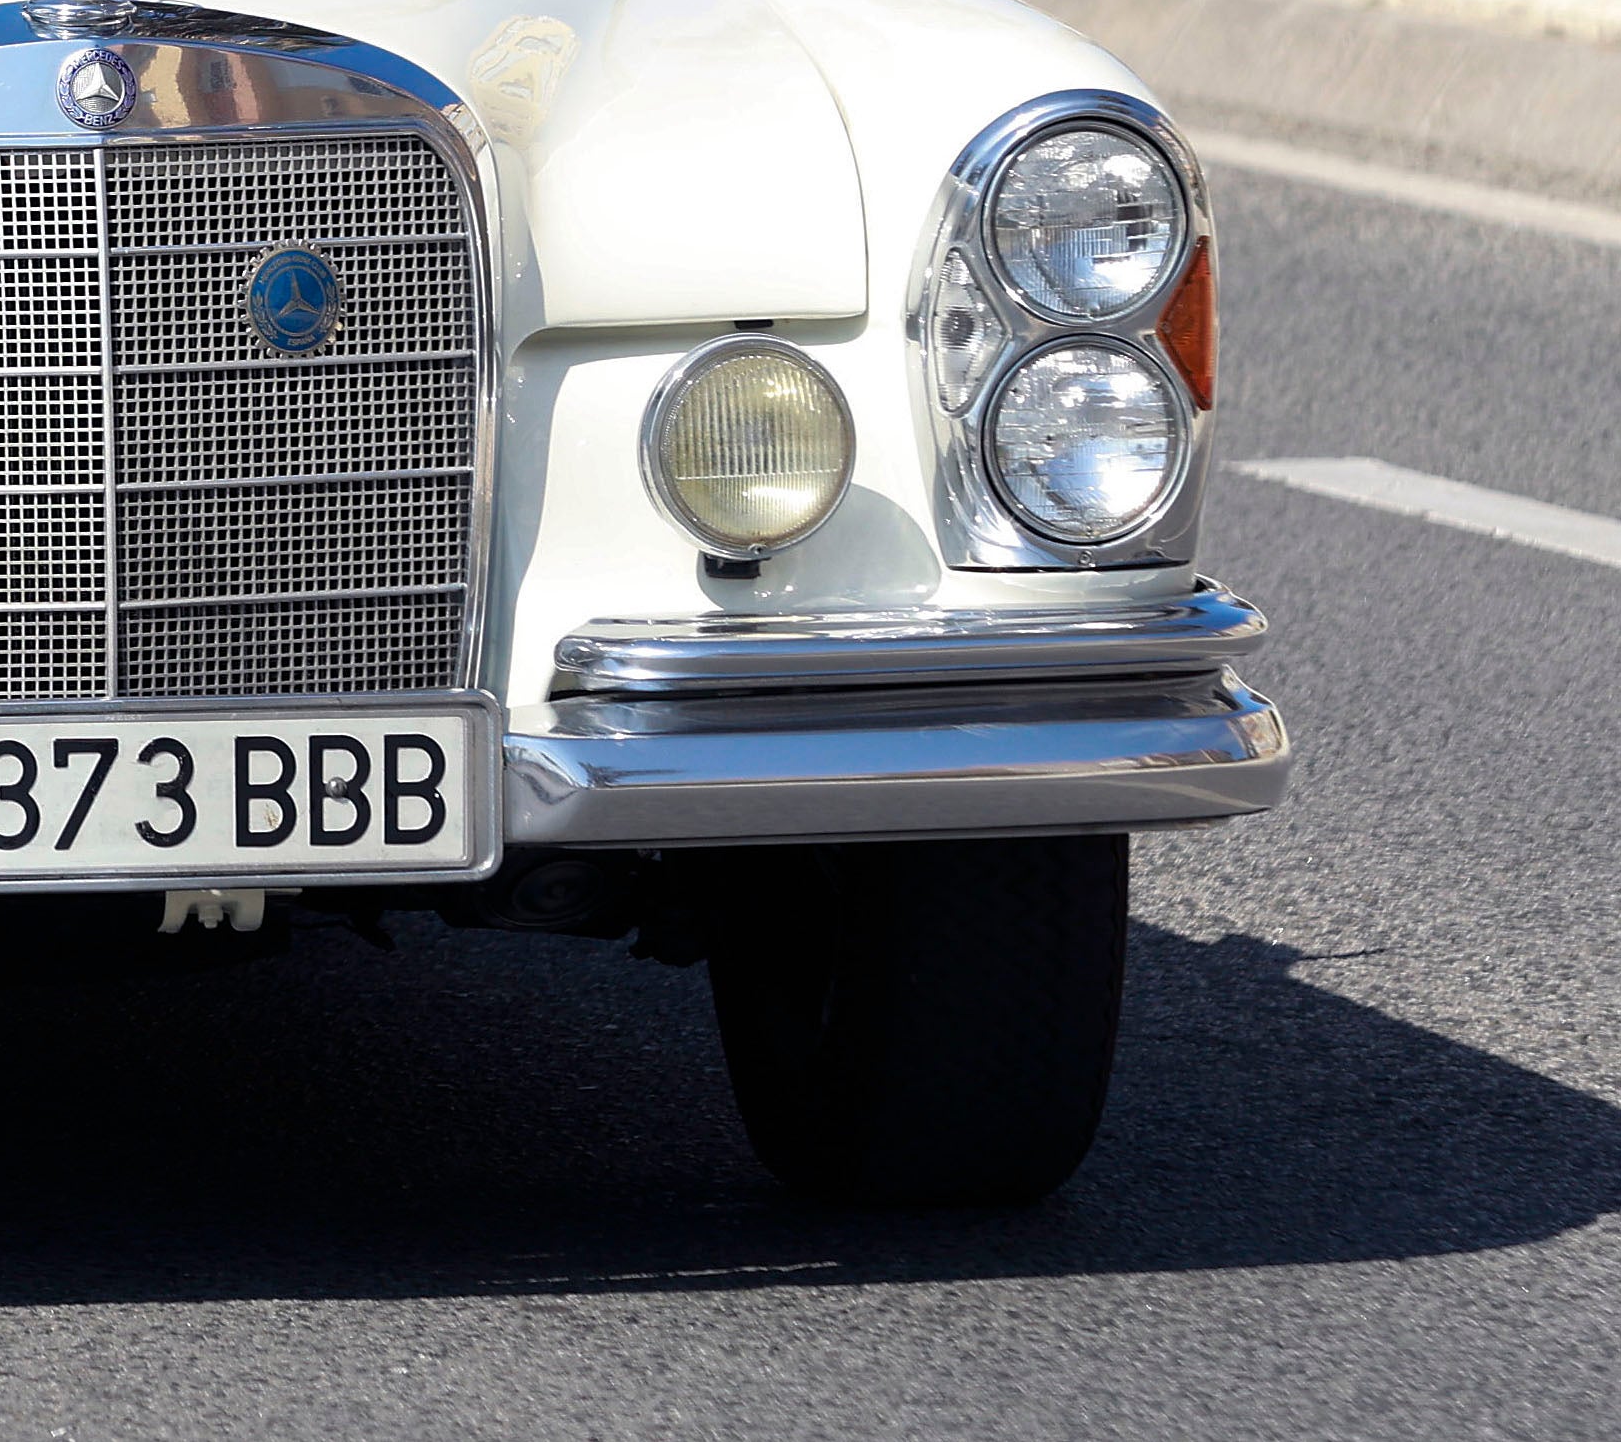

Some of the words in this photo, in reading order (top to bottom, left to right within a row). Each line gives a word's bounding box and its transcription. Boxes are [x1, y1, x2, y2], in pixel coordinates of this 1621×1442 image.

[72, 49, 124, 70] MERCEDES
[84, 113, 116, 126] BENZ
[234, 733, 447, 848] BBB
